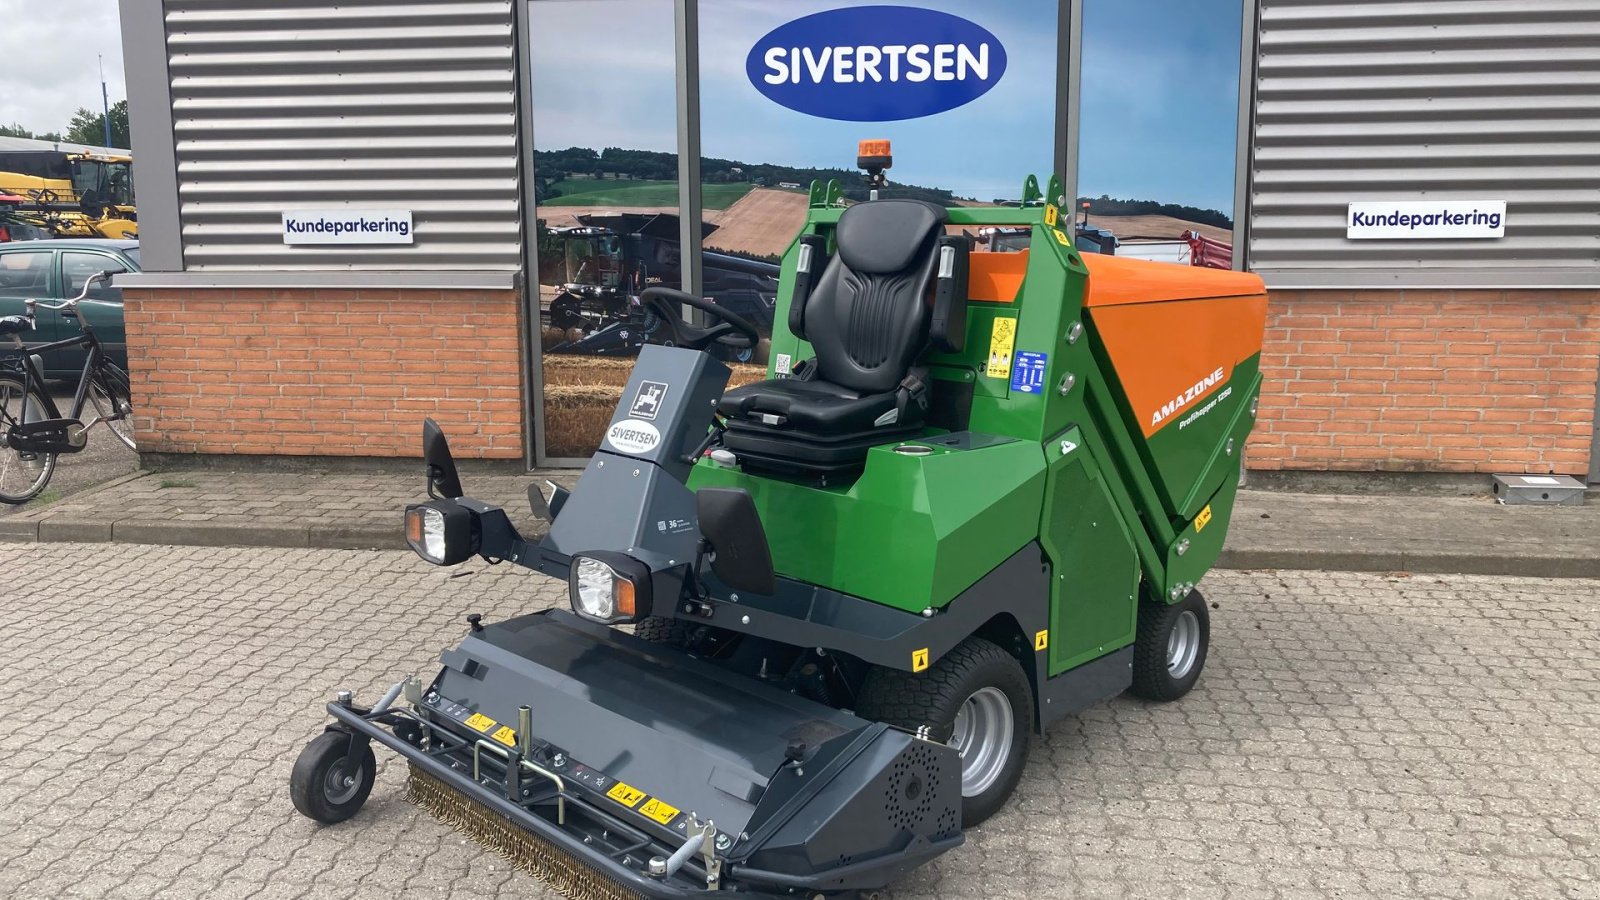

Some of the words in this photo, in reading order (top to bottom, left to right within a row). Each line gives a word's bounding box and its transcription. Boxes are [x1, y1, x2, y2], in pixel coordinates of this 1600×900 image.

[764, 43, 989, 85] SIVERTSEN
[286, 217, 409, 236] Kundeparkering
[1352, 209, 1501, 230] Kundeparkering
[1151, 366, 1224, 427] AMAZONE
[1179, 398, 1217, 431] Profihopper
[610, 426, 658, 445] SIVERTSEN
[668, 519, 678, 529] 36
